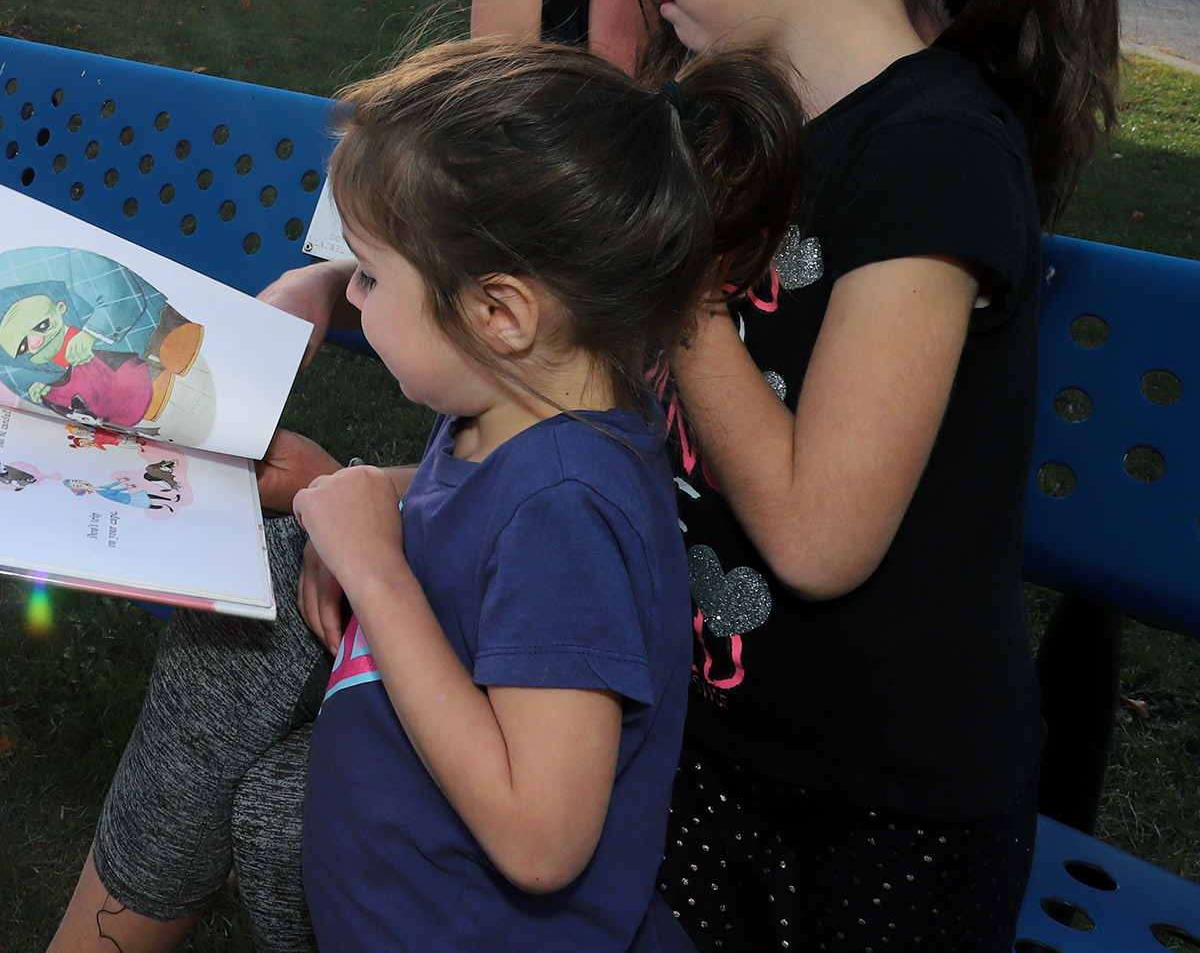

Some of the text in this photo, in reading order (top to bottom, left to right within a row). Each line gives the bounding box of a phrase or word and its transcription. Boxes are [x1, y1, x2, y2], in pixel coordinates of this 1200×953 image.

[87, 513, 102, 538] Don't trip
[109, 526, 118, 540] your
